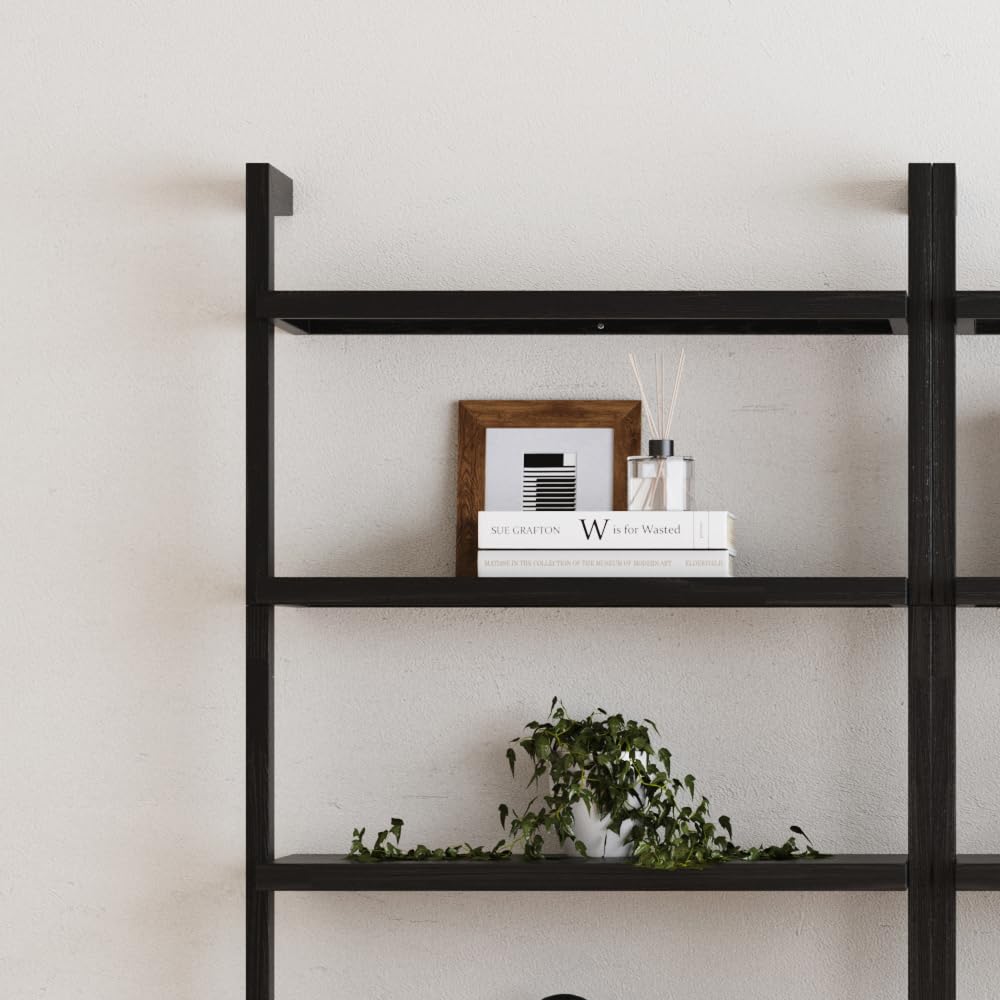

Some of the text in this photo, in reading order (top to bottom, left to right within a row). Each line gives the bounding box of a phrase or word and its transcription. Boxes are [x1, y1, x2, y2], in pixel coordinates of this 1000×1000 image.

[491, 526, 561, 535] SUE GRAFTON
[578, 518, 681, 541] W is for Wasted
